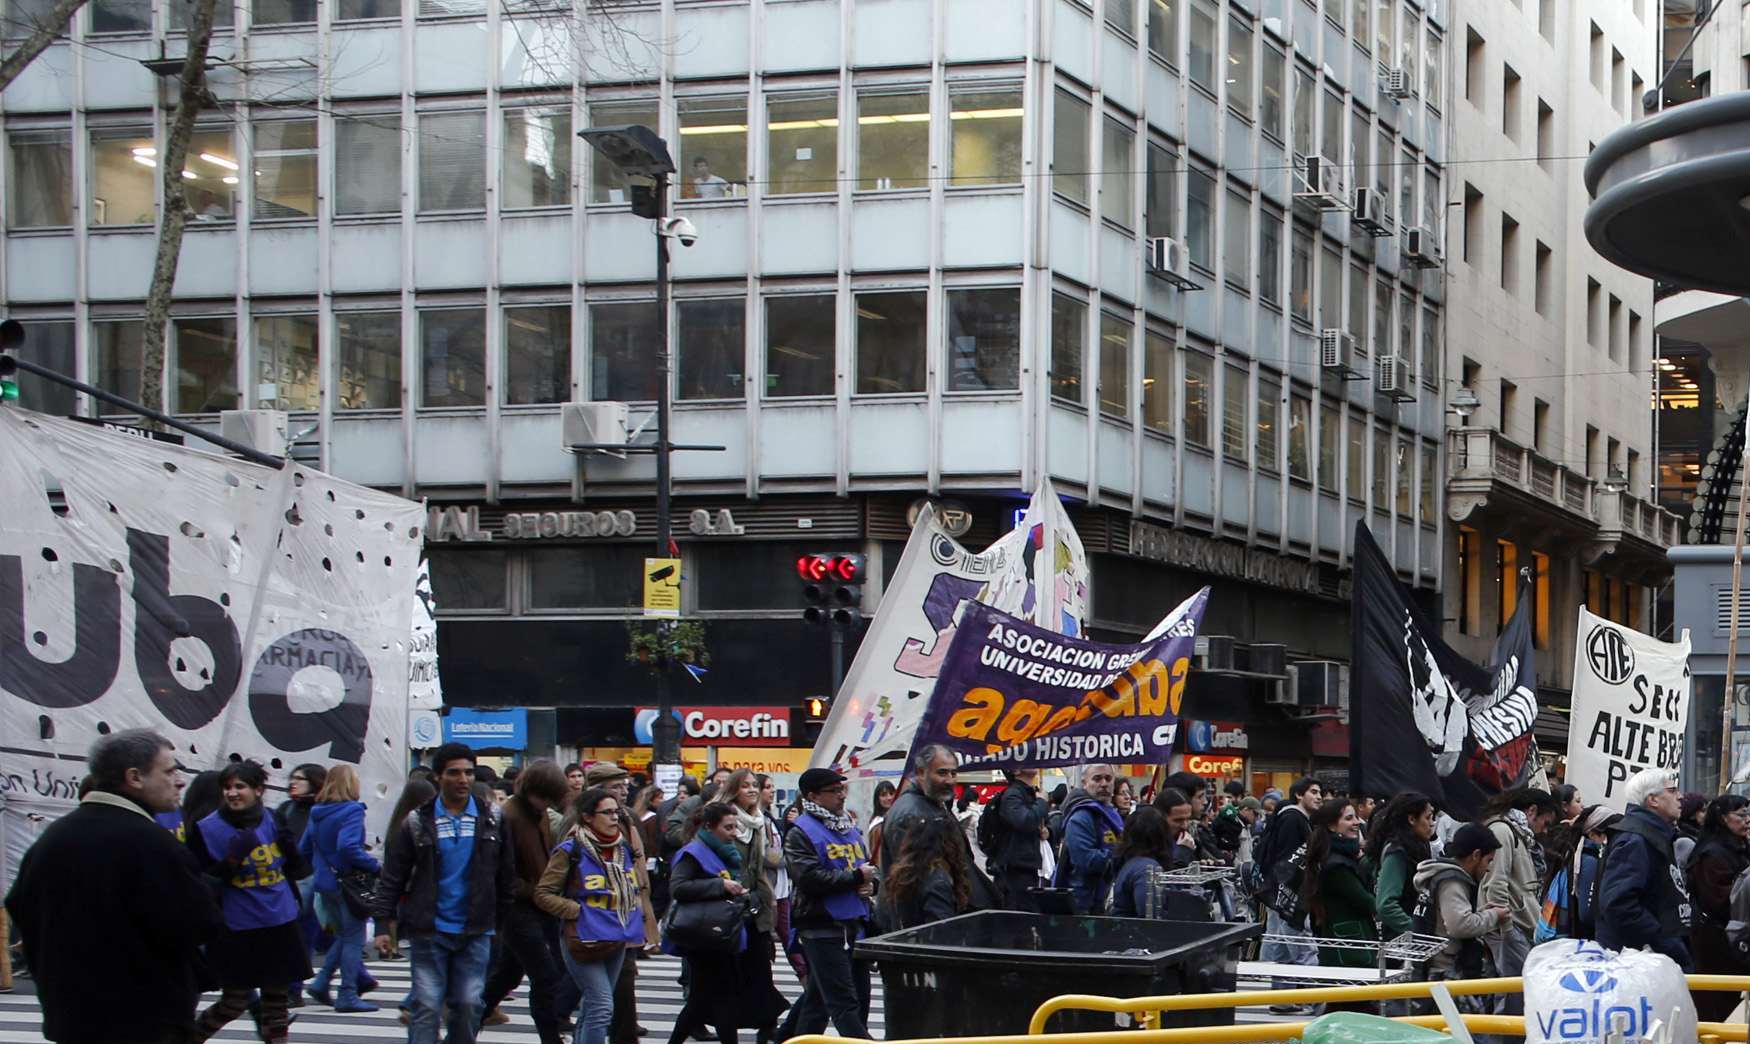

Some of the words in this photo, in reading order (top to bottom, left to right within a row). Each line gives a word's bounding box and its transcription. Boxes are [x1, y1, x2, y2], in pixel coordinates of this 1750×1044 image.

[503, 510, 637, 538] SEGUROS
[689, 508, 745, 536] S.A.
[980, 645, 1101, 690] UNIVERSIDAD
[987, 624, 1106, 670] ASOCIACION
[685, 711, 788, 738] Corefin
[1036, 733, 1144, 761] HISTORICA
[1588, 712, 1655, 763] ALTE
[1536, 995, 1653, 1040] valot
